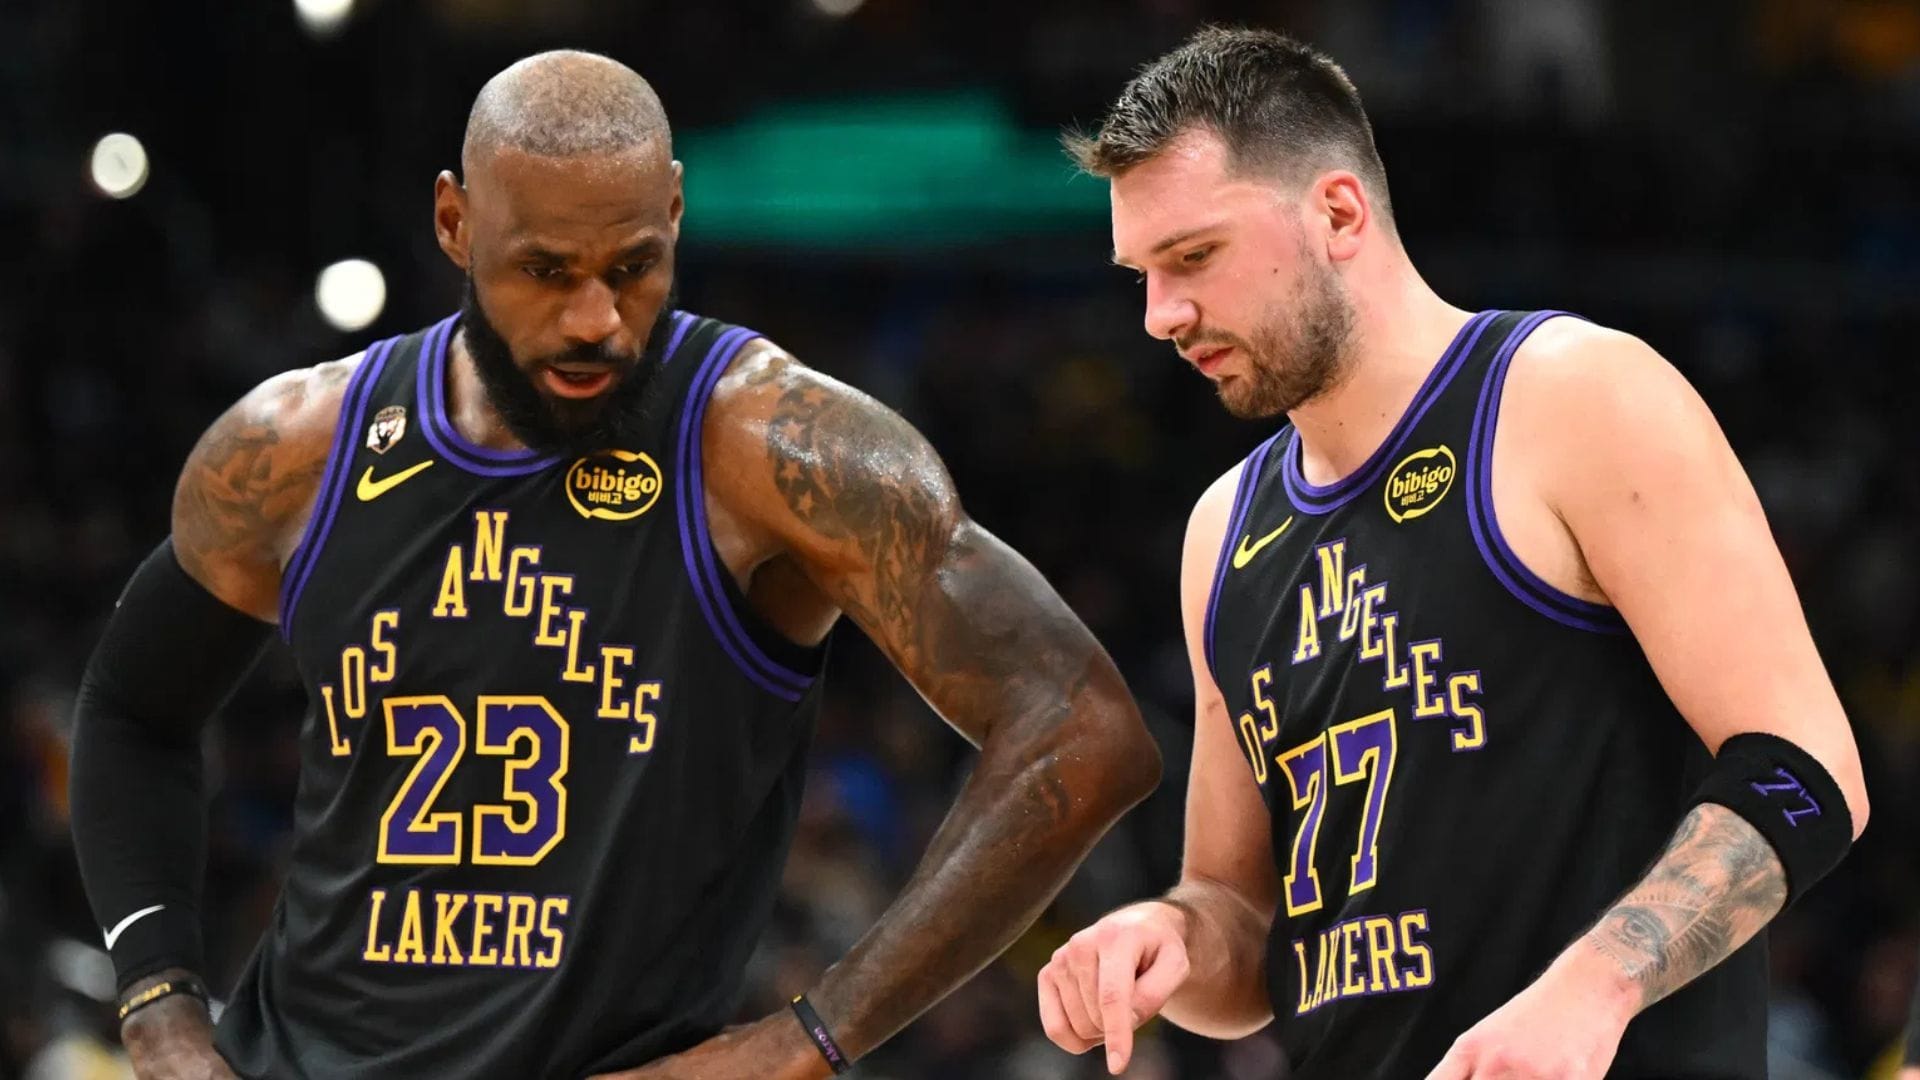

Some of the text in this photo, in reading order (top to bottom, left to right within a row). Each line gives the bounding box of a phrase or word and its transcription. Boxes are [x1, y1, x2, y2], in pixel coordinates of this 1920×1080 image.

[576, 466, 657, 501] bibigo
[588, 491, 623, 505] 비비고
[1392, 466, 1452, 498] bibigo
[320, 509, 663, 757] LOS ANGELES
[1238, 537, 1488, 785] OS ANGELES
[376, 694, 570, 866] 23
[1274, 707, 1398, 918] 77
[1751, 768, 1821, 827] 77
[362, 886, 572, 970] LAKERS
[1291, 908, 1436, 1017] LAKERS
